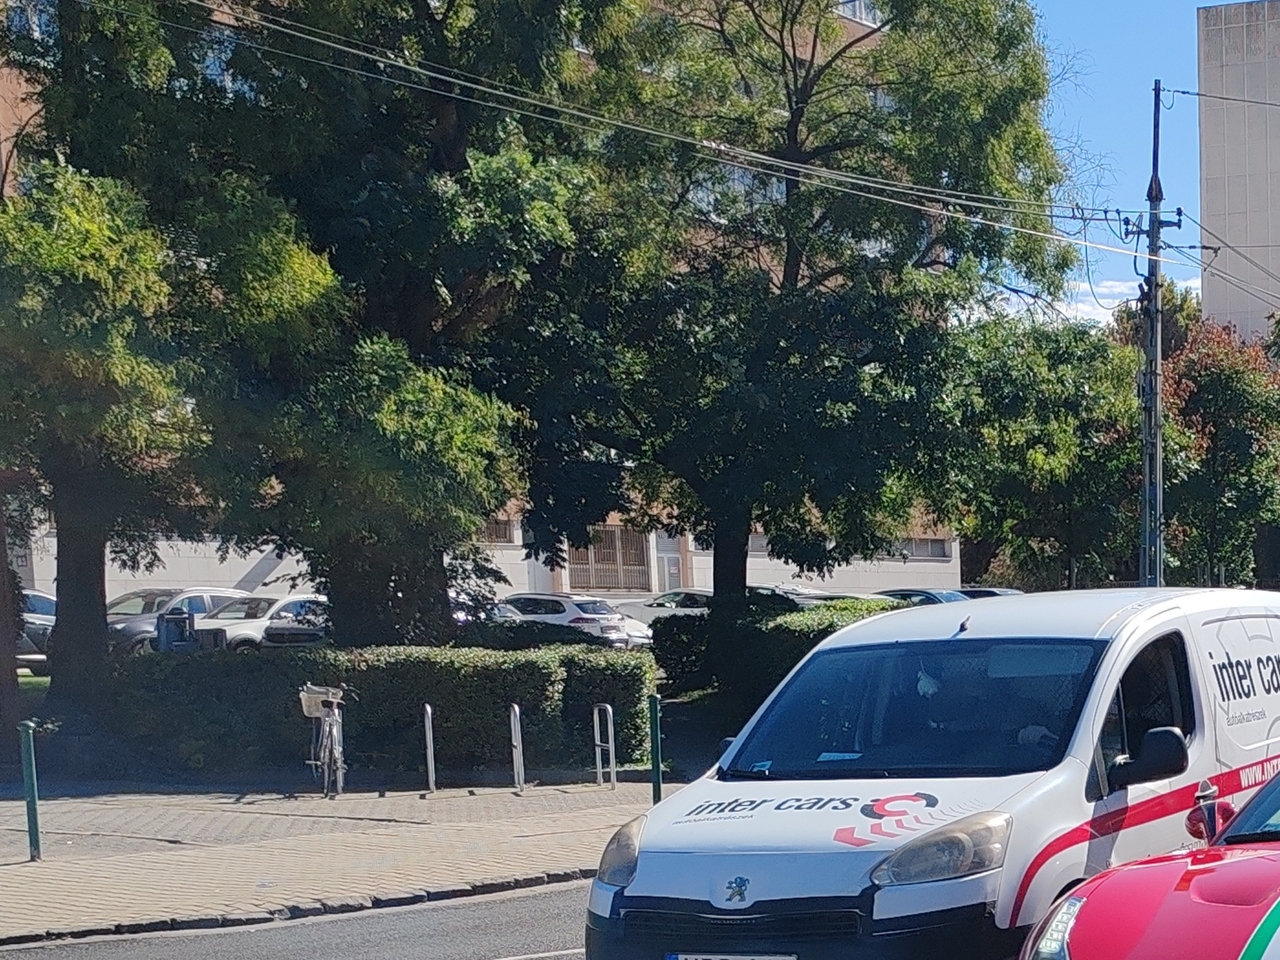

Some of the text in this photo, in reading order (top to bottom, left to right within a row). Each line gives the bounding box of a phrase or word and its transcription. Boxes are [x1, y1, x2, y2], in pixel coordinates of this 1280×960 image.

[1208, 652, 1257, 703] inter
[684, 795, 861, 817] inter cars
